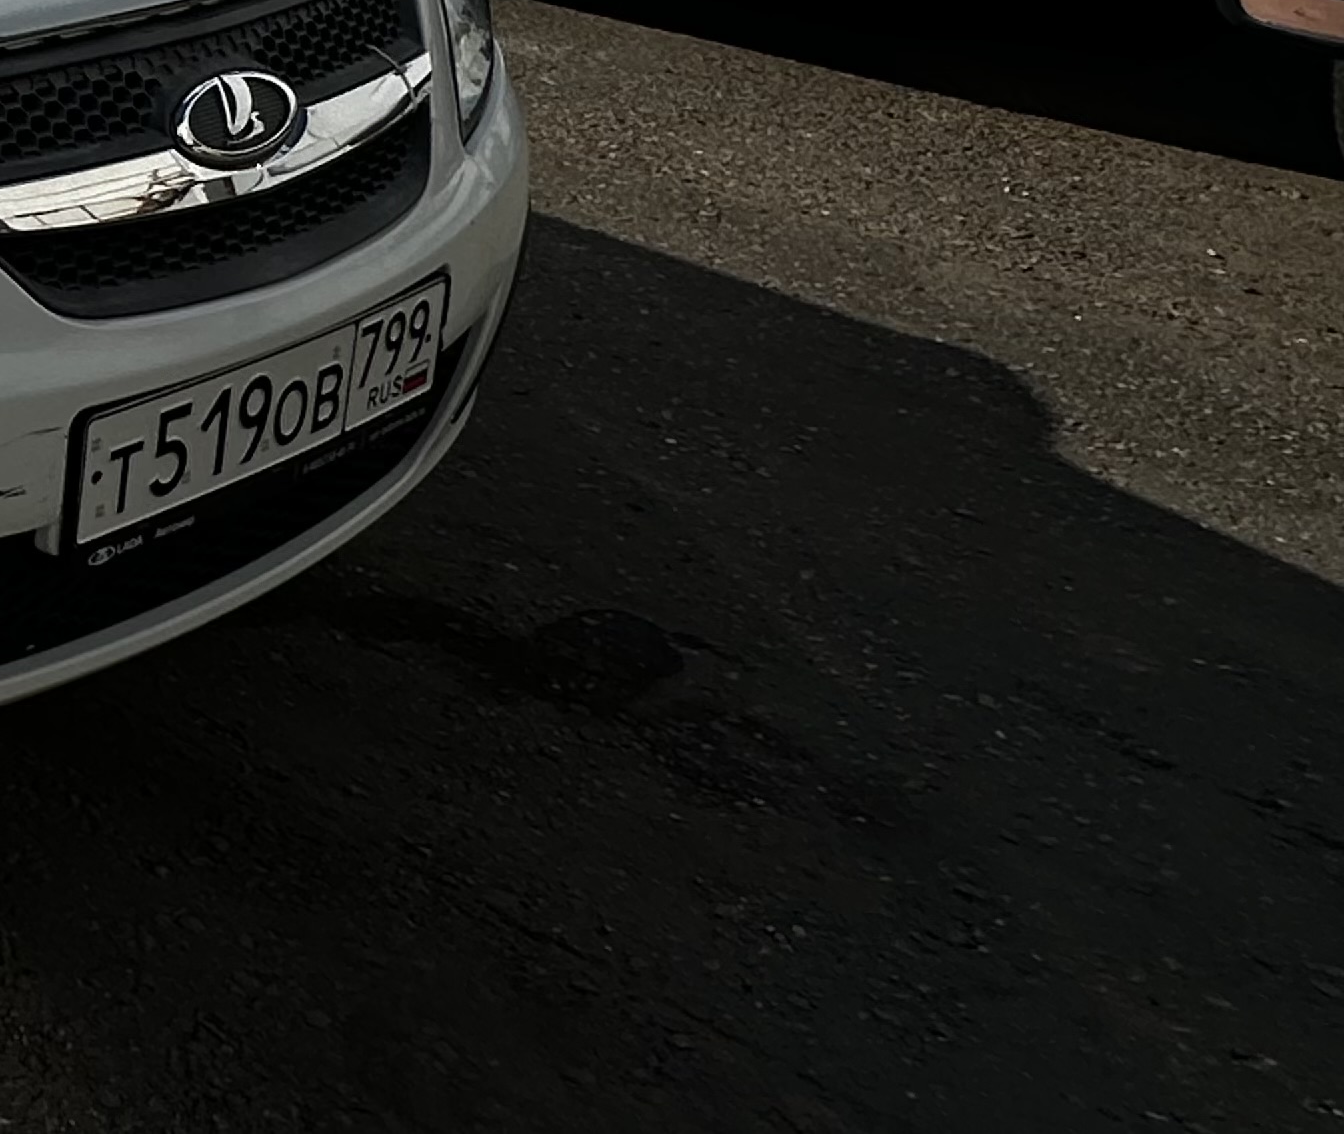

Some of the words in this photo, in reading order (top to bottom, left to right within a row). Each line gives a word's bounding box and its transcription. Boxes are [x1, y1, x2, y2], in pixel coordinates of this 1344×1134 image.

[110, 362, 344, 514] Т519ОВ
[358, 299, 430, 389] 799
[367, 374, 402, 411] RUS
